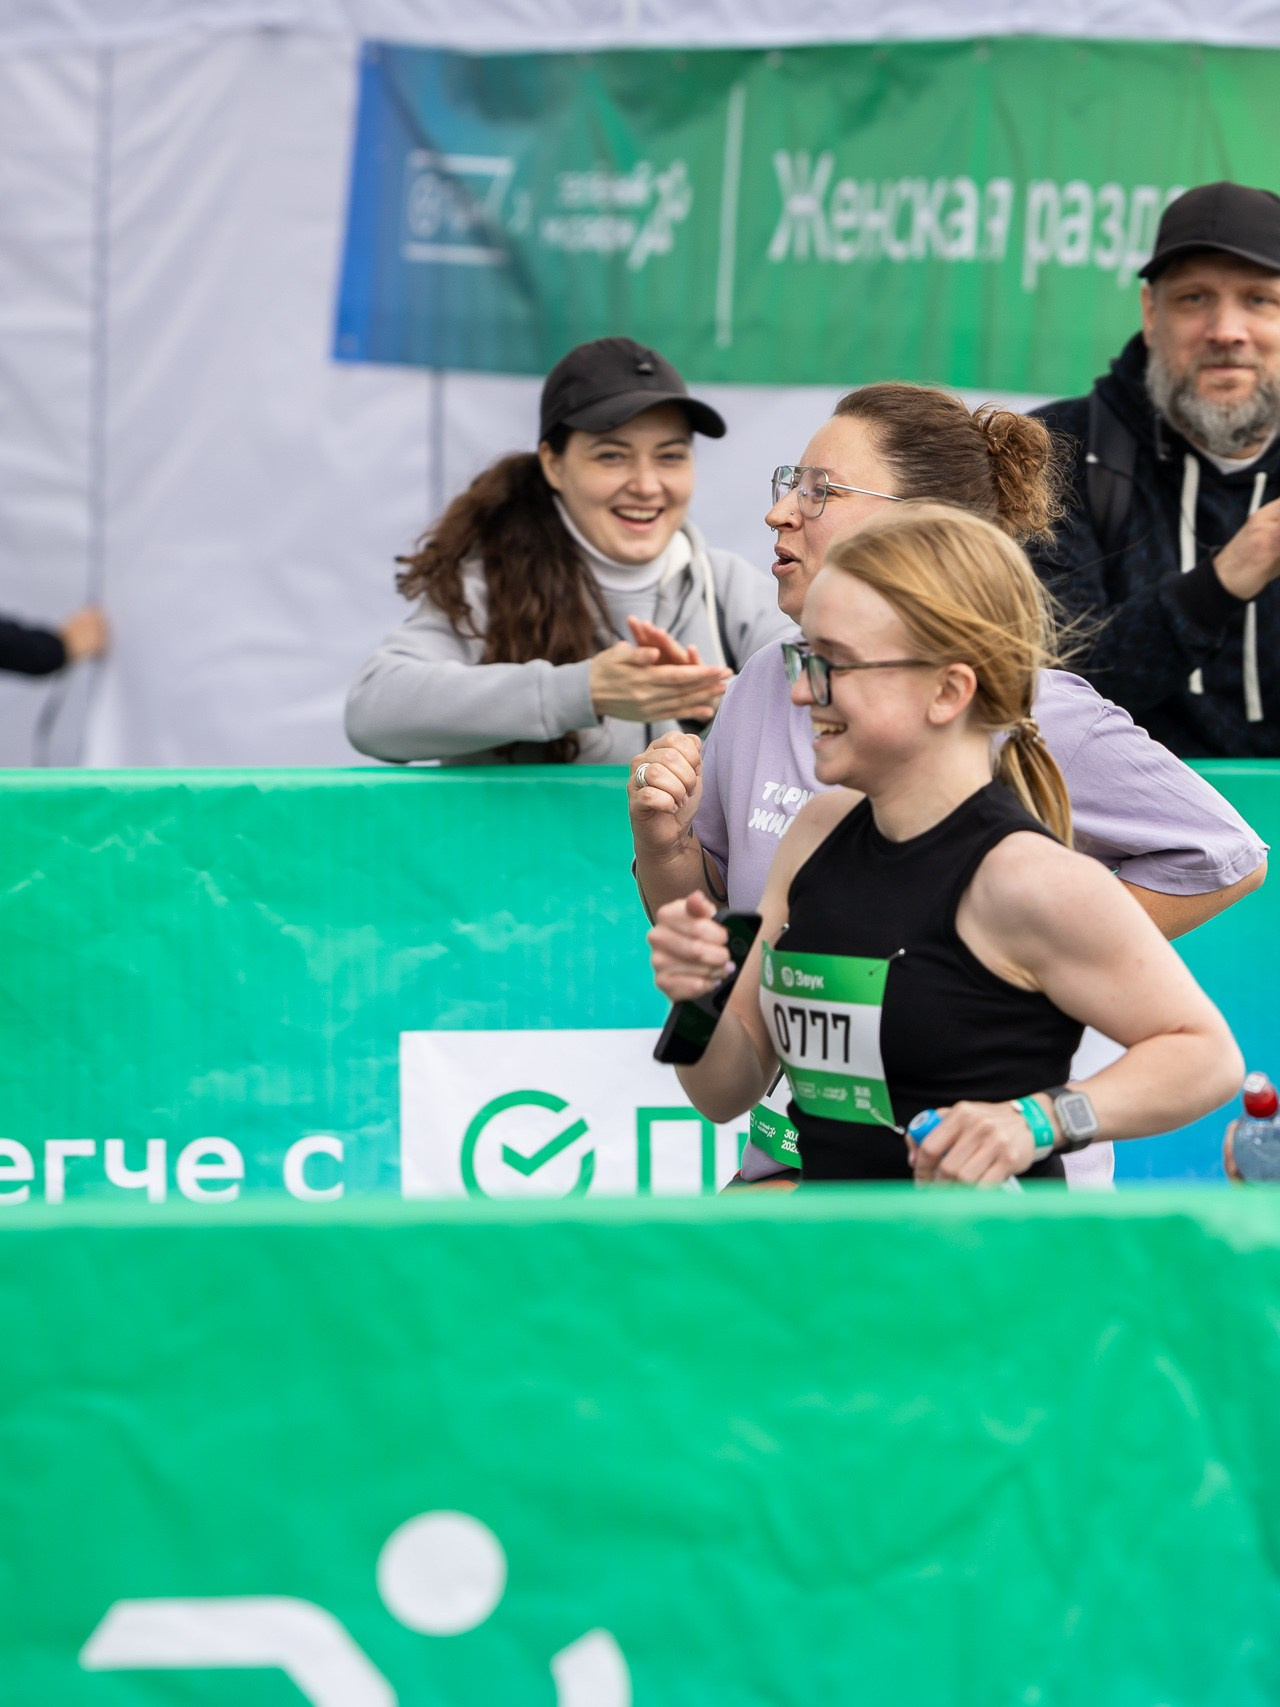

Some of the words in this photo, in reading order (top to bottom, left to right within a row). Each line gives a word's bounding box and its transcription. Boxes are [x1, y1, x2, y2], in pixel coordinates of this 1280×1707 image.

[767, 150, 1016, 265] Женская
[773, 1002, 851, 1064] 0777
[282, 1134, 345, 1203] с
